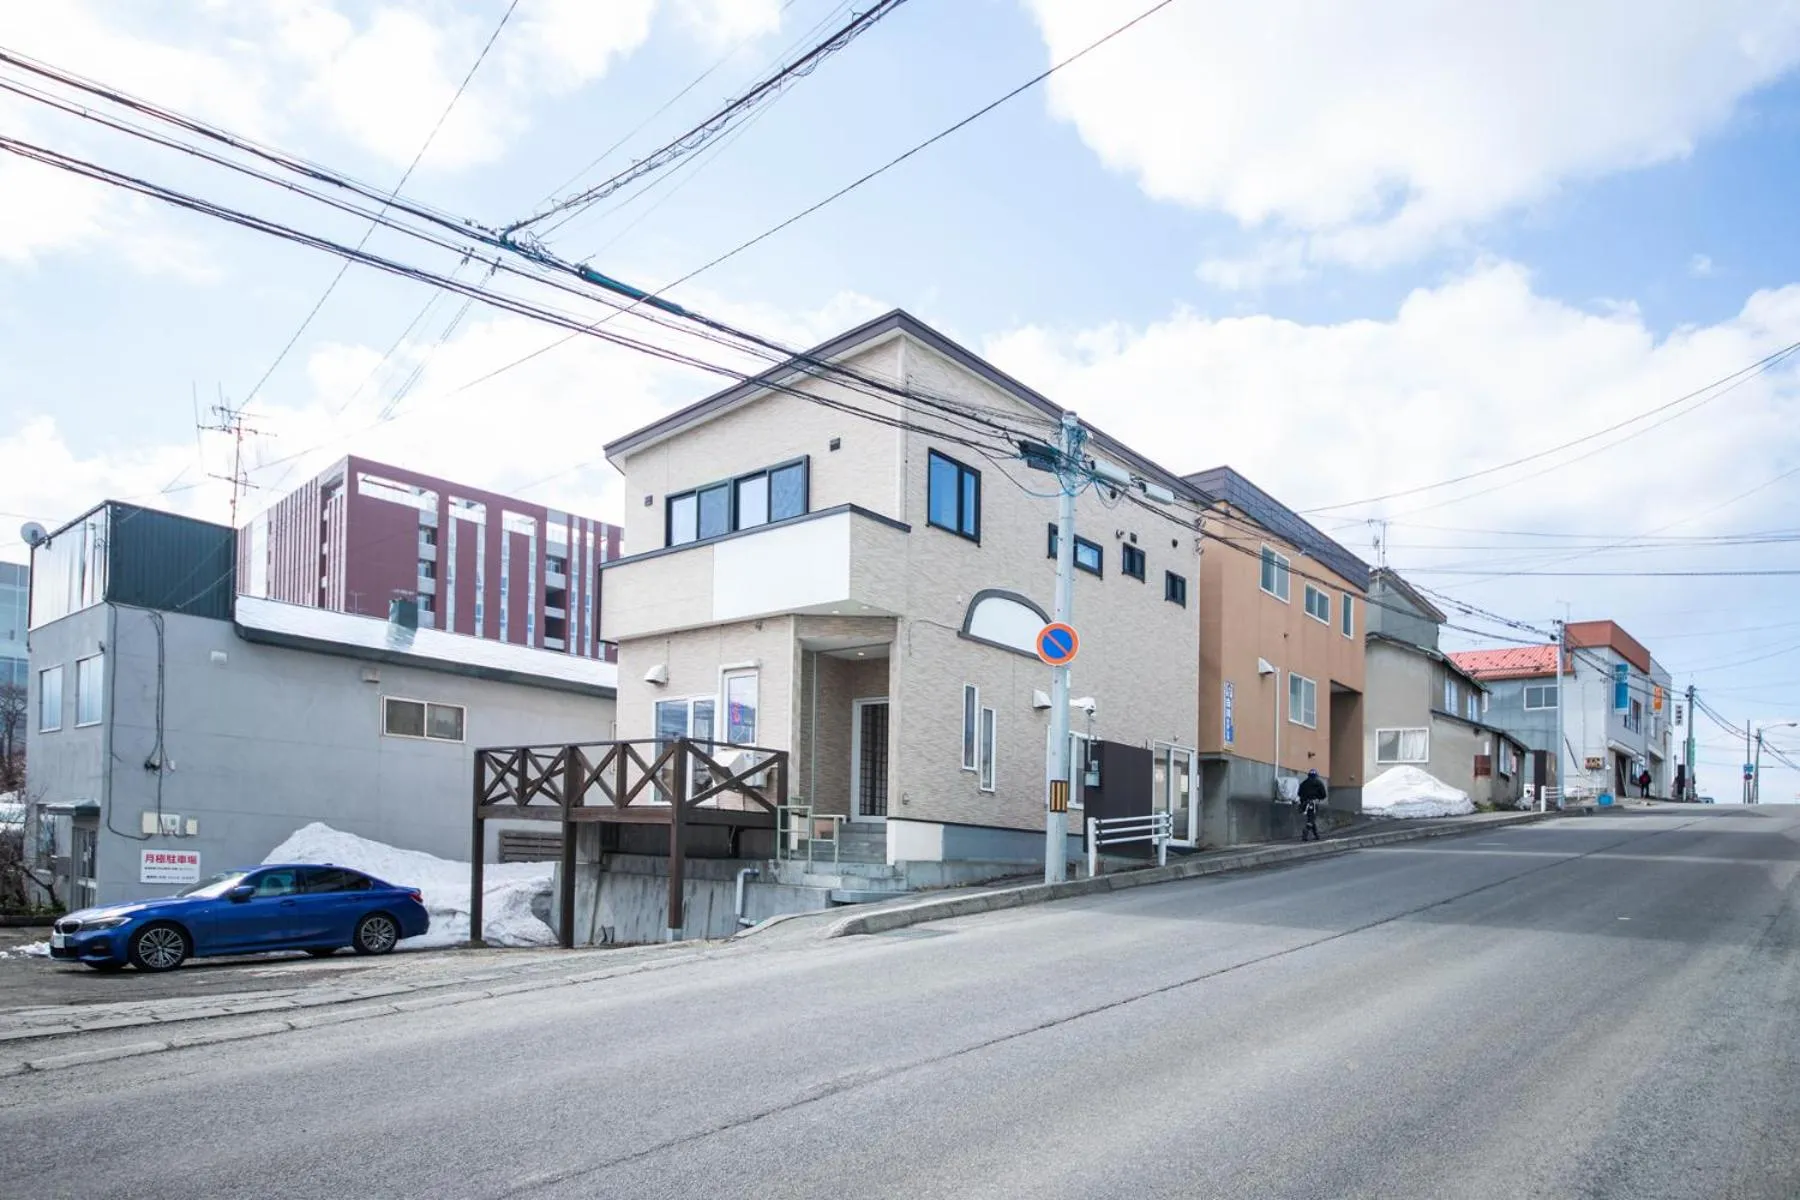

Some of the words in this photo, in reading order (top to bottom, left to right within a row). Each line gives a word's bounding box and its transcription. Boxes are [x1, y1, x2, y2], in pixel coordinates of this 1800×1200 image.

[145, 853, 198, 865] 月極駐車場
